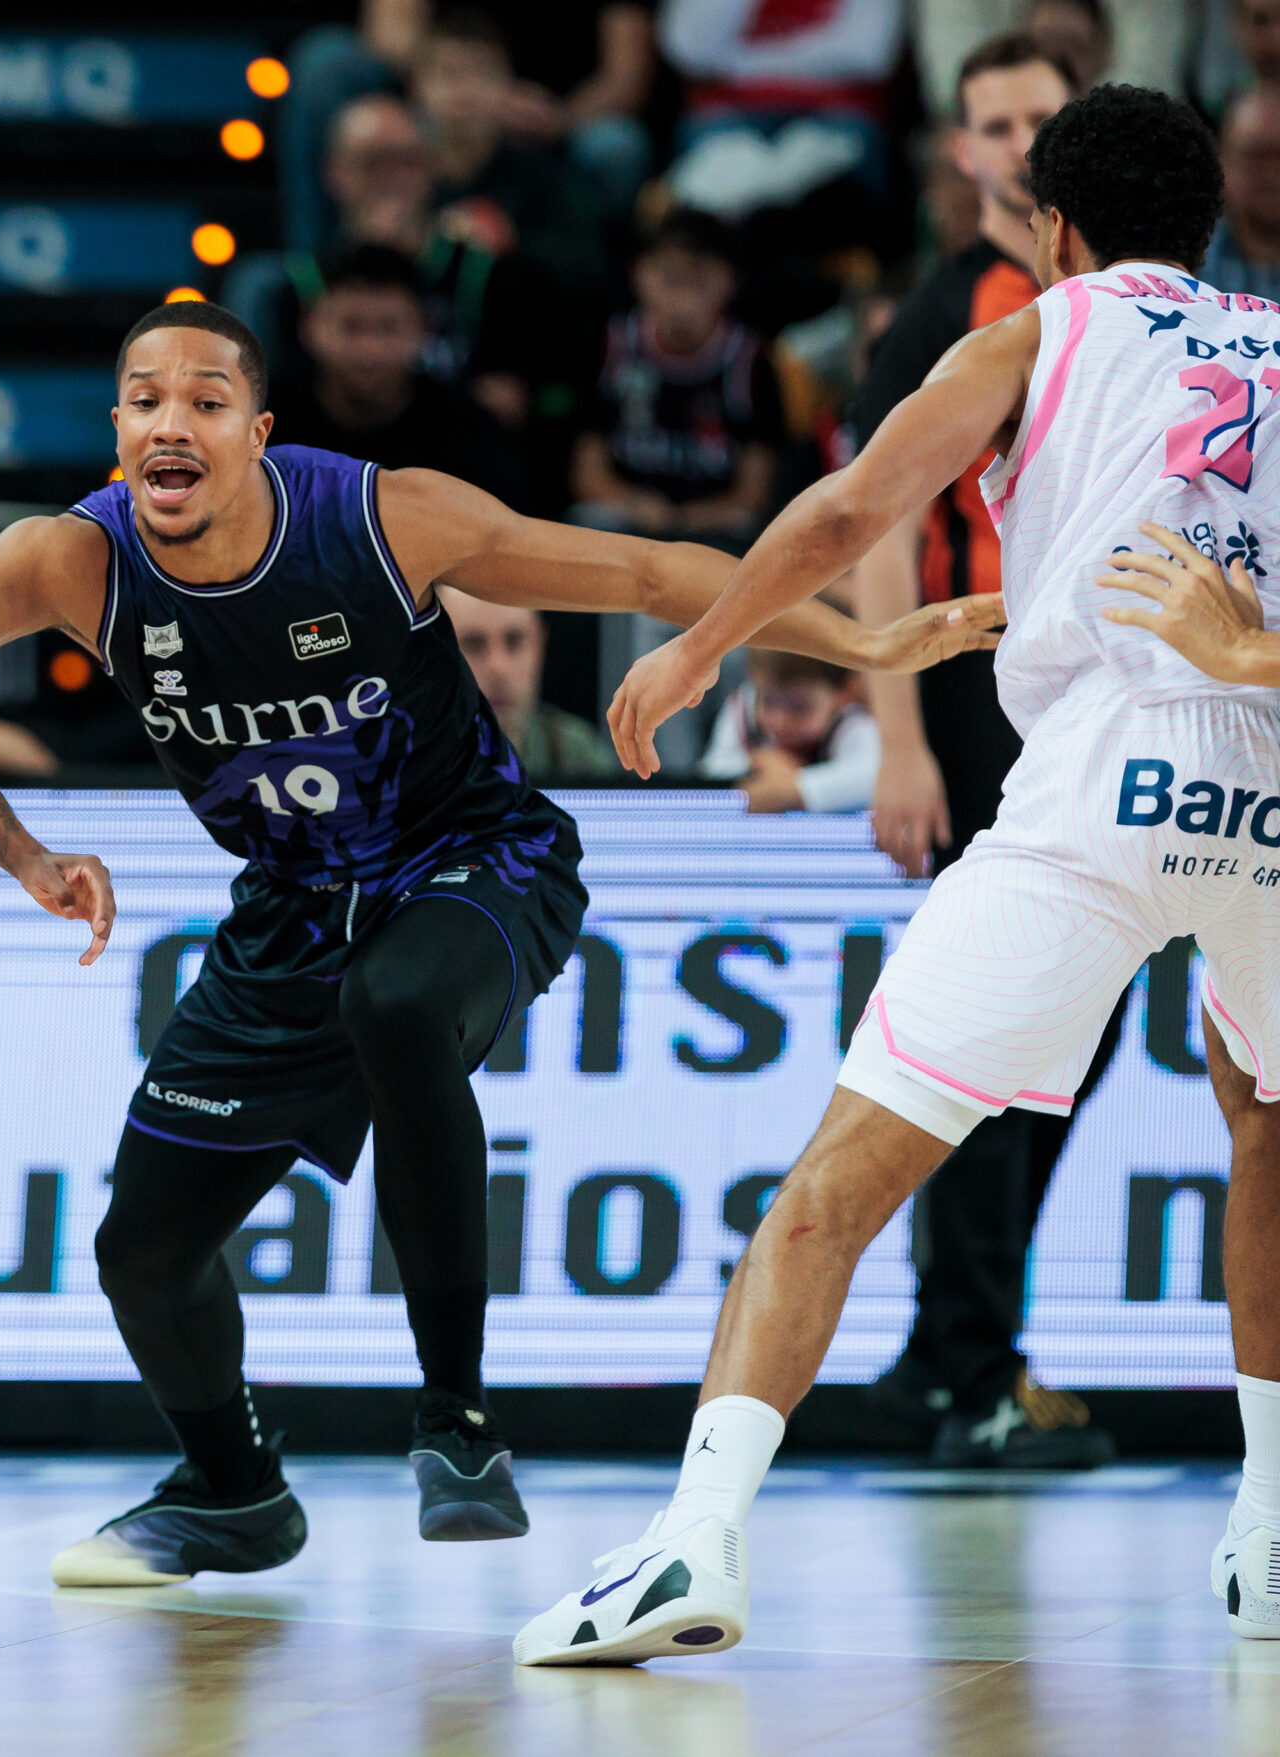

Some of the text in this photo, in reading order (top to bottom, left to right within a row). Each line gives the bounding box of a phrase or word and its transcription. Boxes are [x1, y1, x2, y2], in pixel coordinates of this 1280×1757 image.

[297, 633, 319, 645] liga
[300, 635, 346, 654] endesa
[141, 676, 391, 747] surne
[247, 764, 340, 817] 19
[1161, 853, 1239, 877] HOTEL
[146, 1081, 164, 1100] EL
[164, 1090, 234, 1118] CORREO
